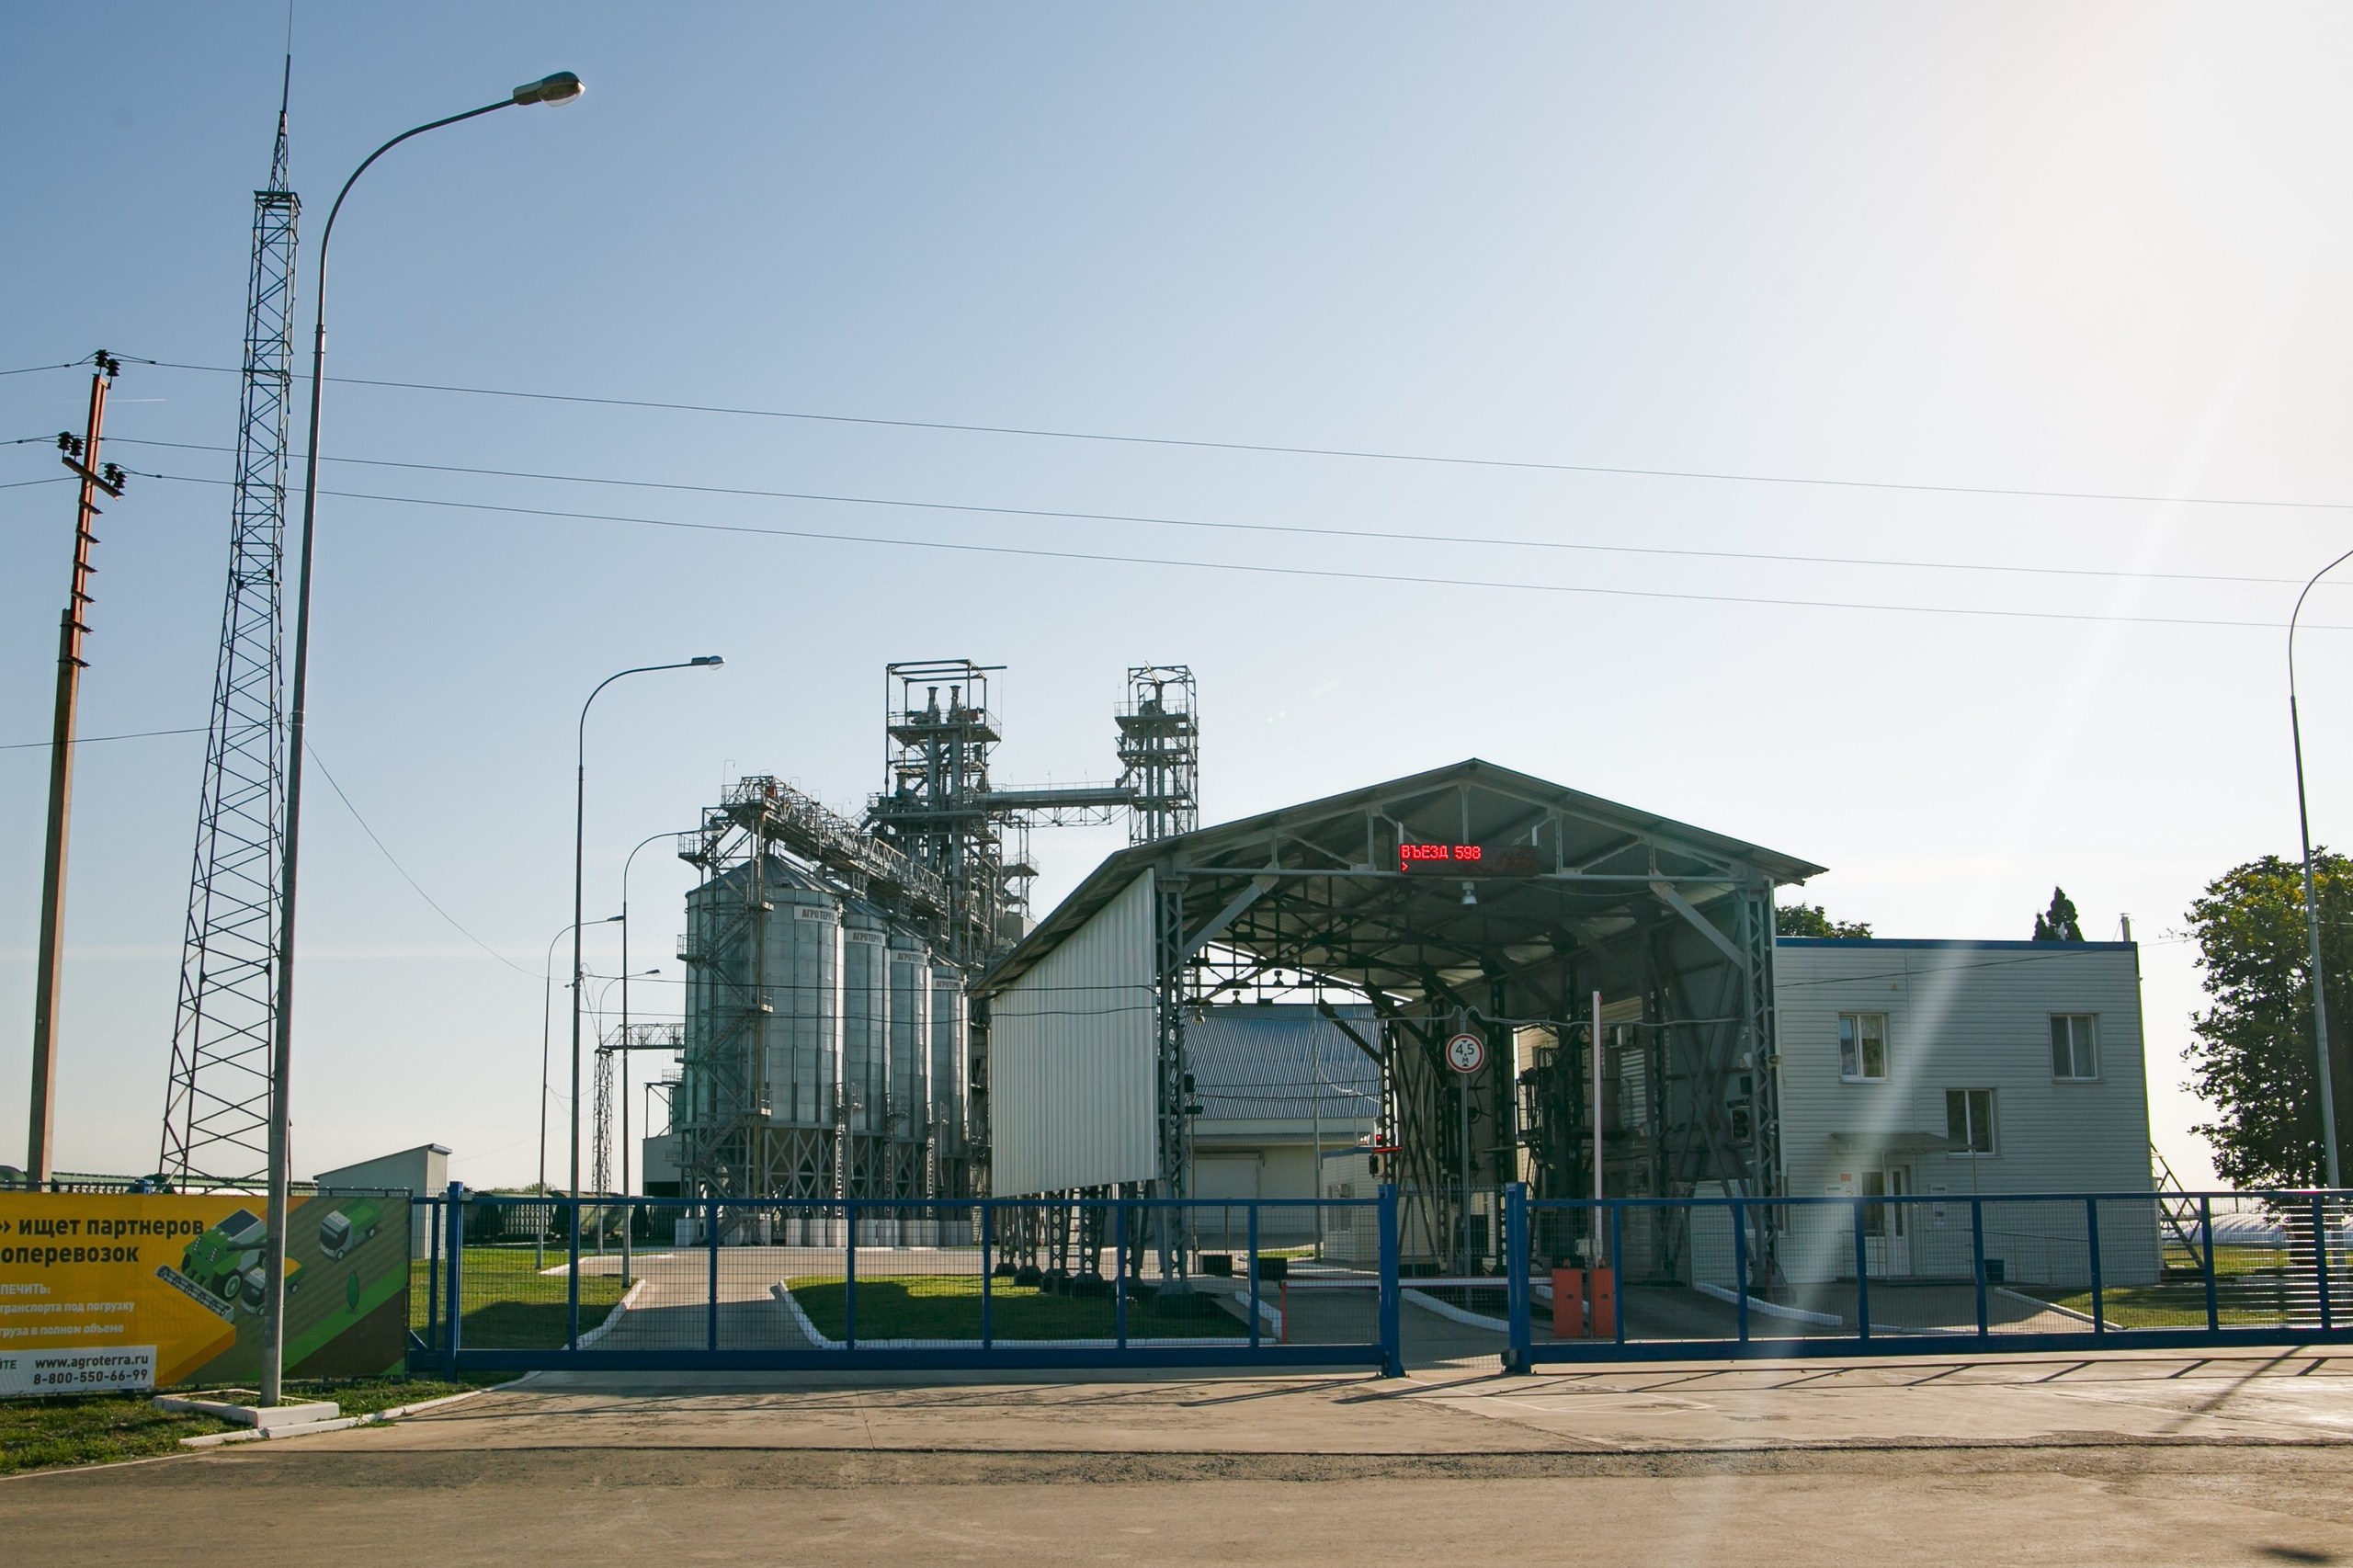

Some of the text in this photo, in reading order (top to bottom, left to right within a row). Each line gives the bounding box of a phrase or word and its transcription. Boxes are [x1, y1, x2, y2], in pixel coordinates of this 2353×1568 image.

[1400, 844, 1482, 860] ВЪЕЗД 598
[18, 1219, 204, 1240] ищет партнеров
[1, 1246, 140, 1267] оперевозок
[64, 1301, 85, 1312] под
[86, 1301, 135, 1312] погрузку
[30, 1326, 38, 1335] в
[40, 1324, 82, 1335] полном
[35, 1355, 149, 1369] www.agroterra.ru
[33, 1369, 148, 1385] 8-800-550-66-99
